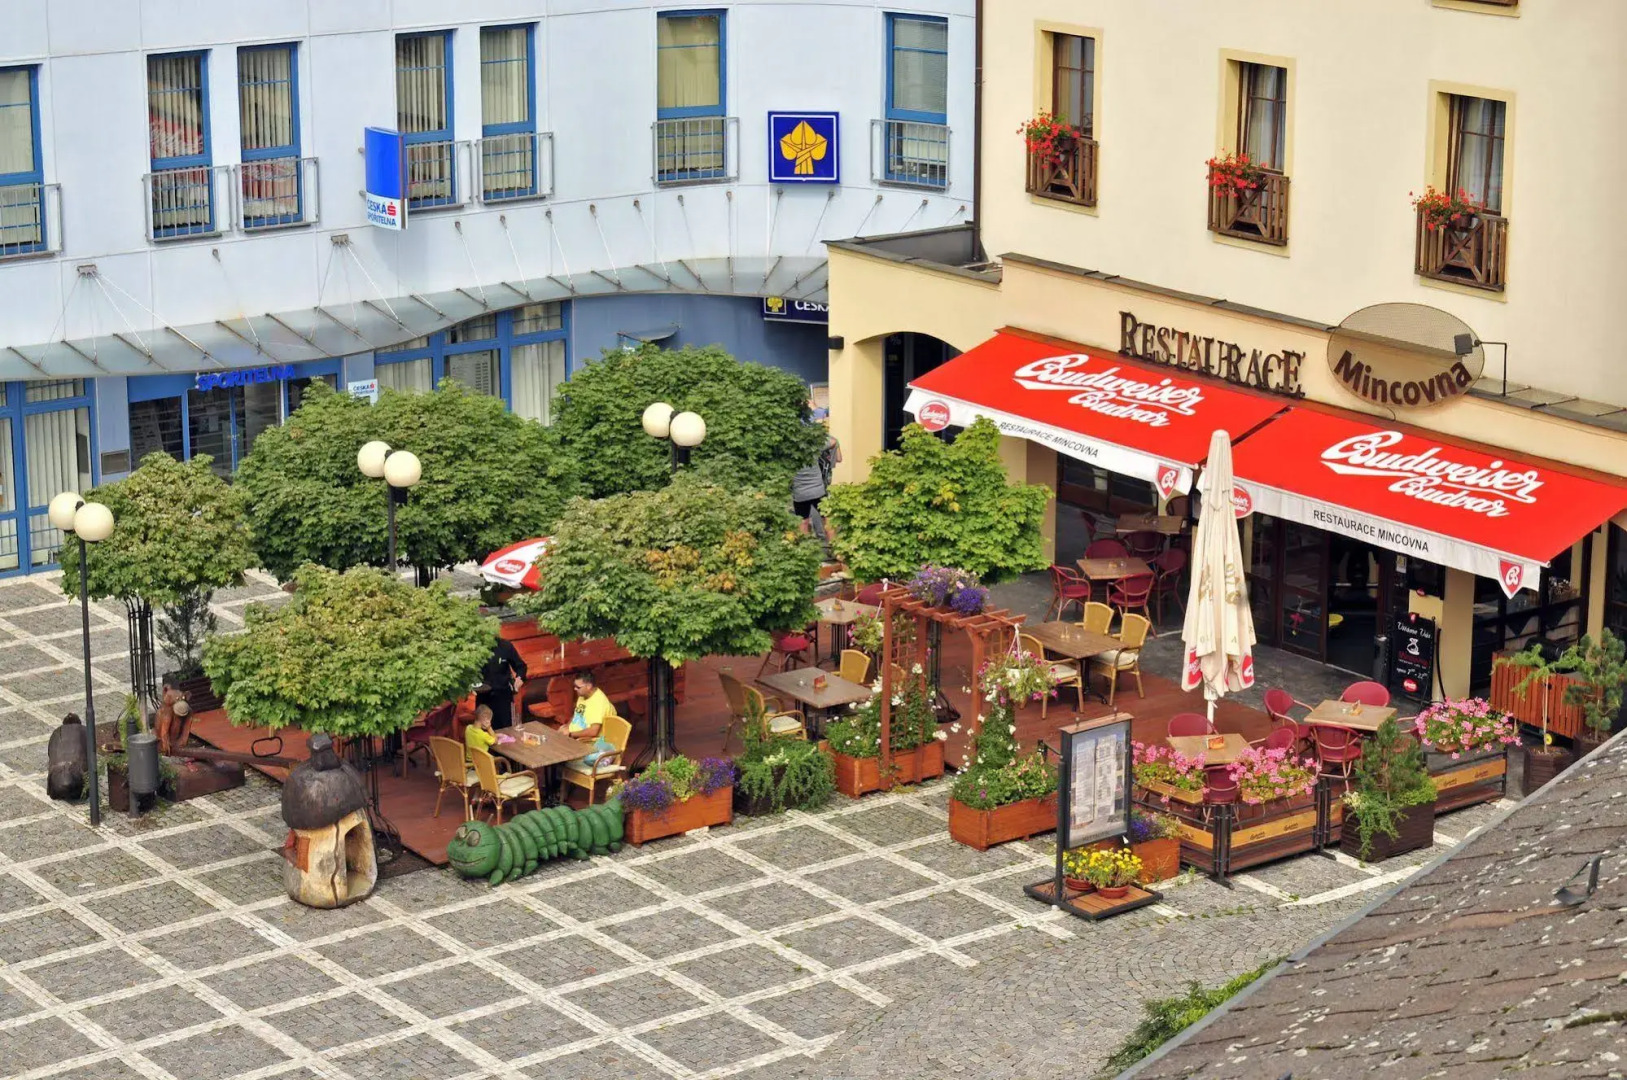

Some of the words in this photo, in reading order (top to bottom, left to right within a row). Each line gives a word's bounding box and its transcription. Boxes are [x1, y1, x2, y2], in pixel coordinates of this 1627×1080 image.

[1118, 310, 1306, 398] RESTAURACE
[1334, 350, 1472, 405] Mincovna
[1013, 354, 1205, 416] Budweiser
[1068, 390, 1170, 427] Budvar
[999, 421, 1053, 441] RESTAURACE
[1053, 435, 1100, 458] MINCOVNA
[1320, 431, 1544, 504] Budweiser
[1388, 476, 1509, 517] Budvar
[1313, 509, 1376, 537] RESTAURACE
[1377, 528, 1429, 552] MINCOVNA
